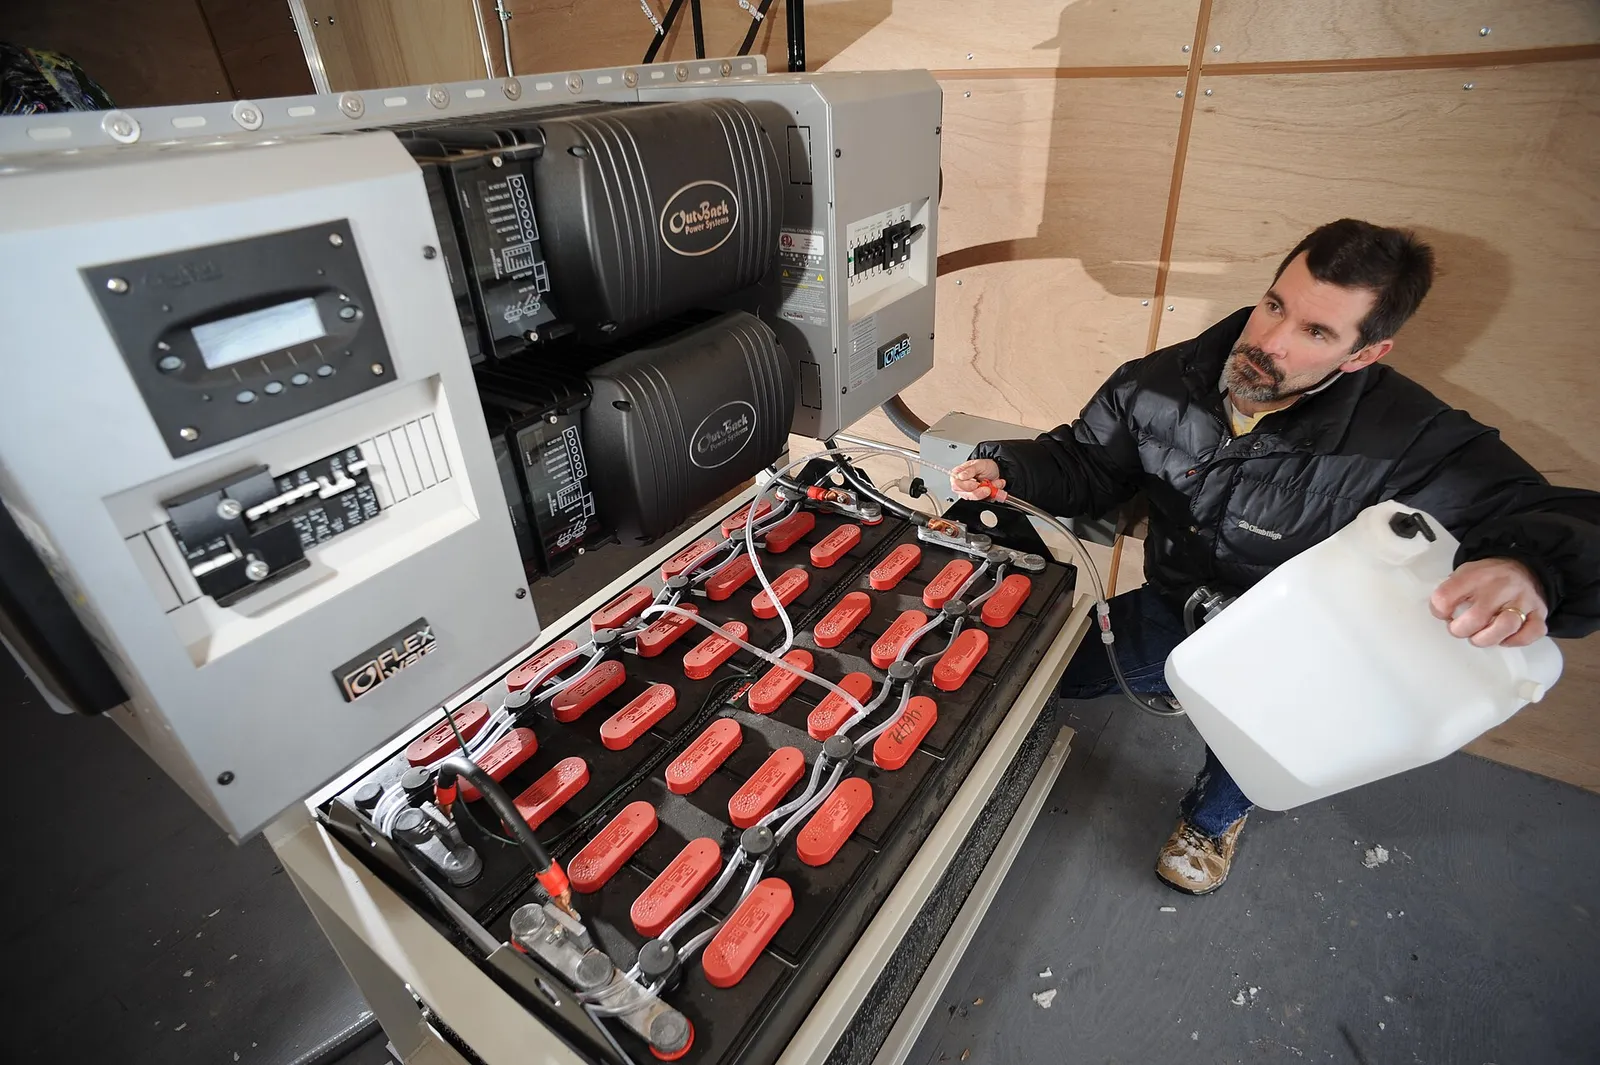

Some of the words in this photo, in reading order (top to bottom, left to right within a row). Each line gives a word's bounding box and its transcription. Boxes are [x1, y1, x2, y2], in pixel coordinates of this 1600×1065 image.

[669, 200, 729, 234] OutBack
[685, 223, 704, 235] Power
[705, 216, 729, 231] Systems
[697, 413, 748, 453] OutBack
[710, 438, 727, 452] Power
[728, 426, 748, 442] Systems
[377, 625, 435, 670] FLEX
